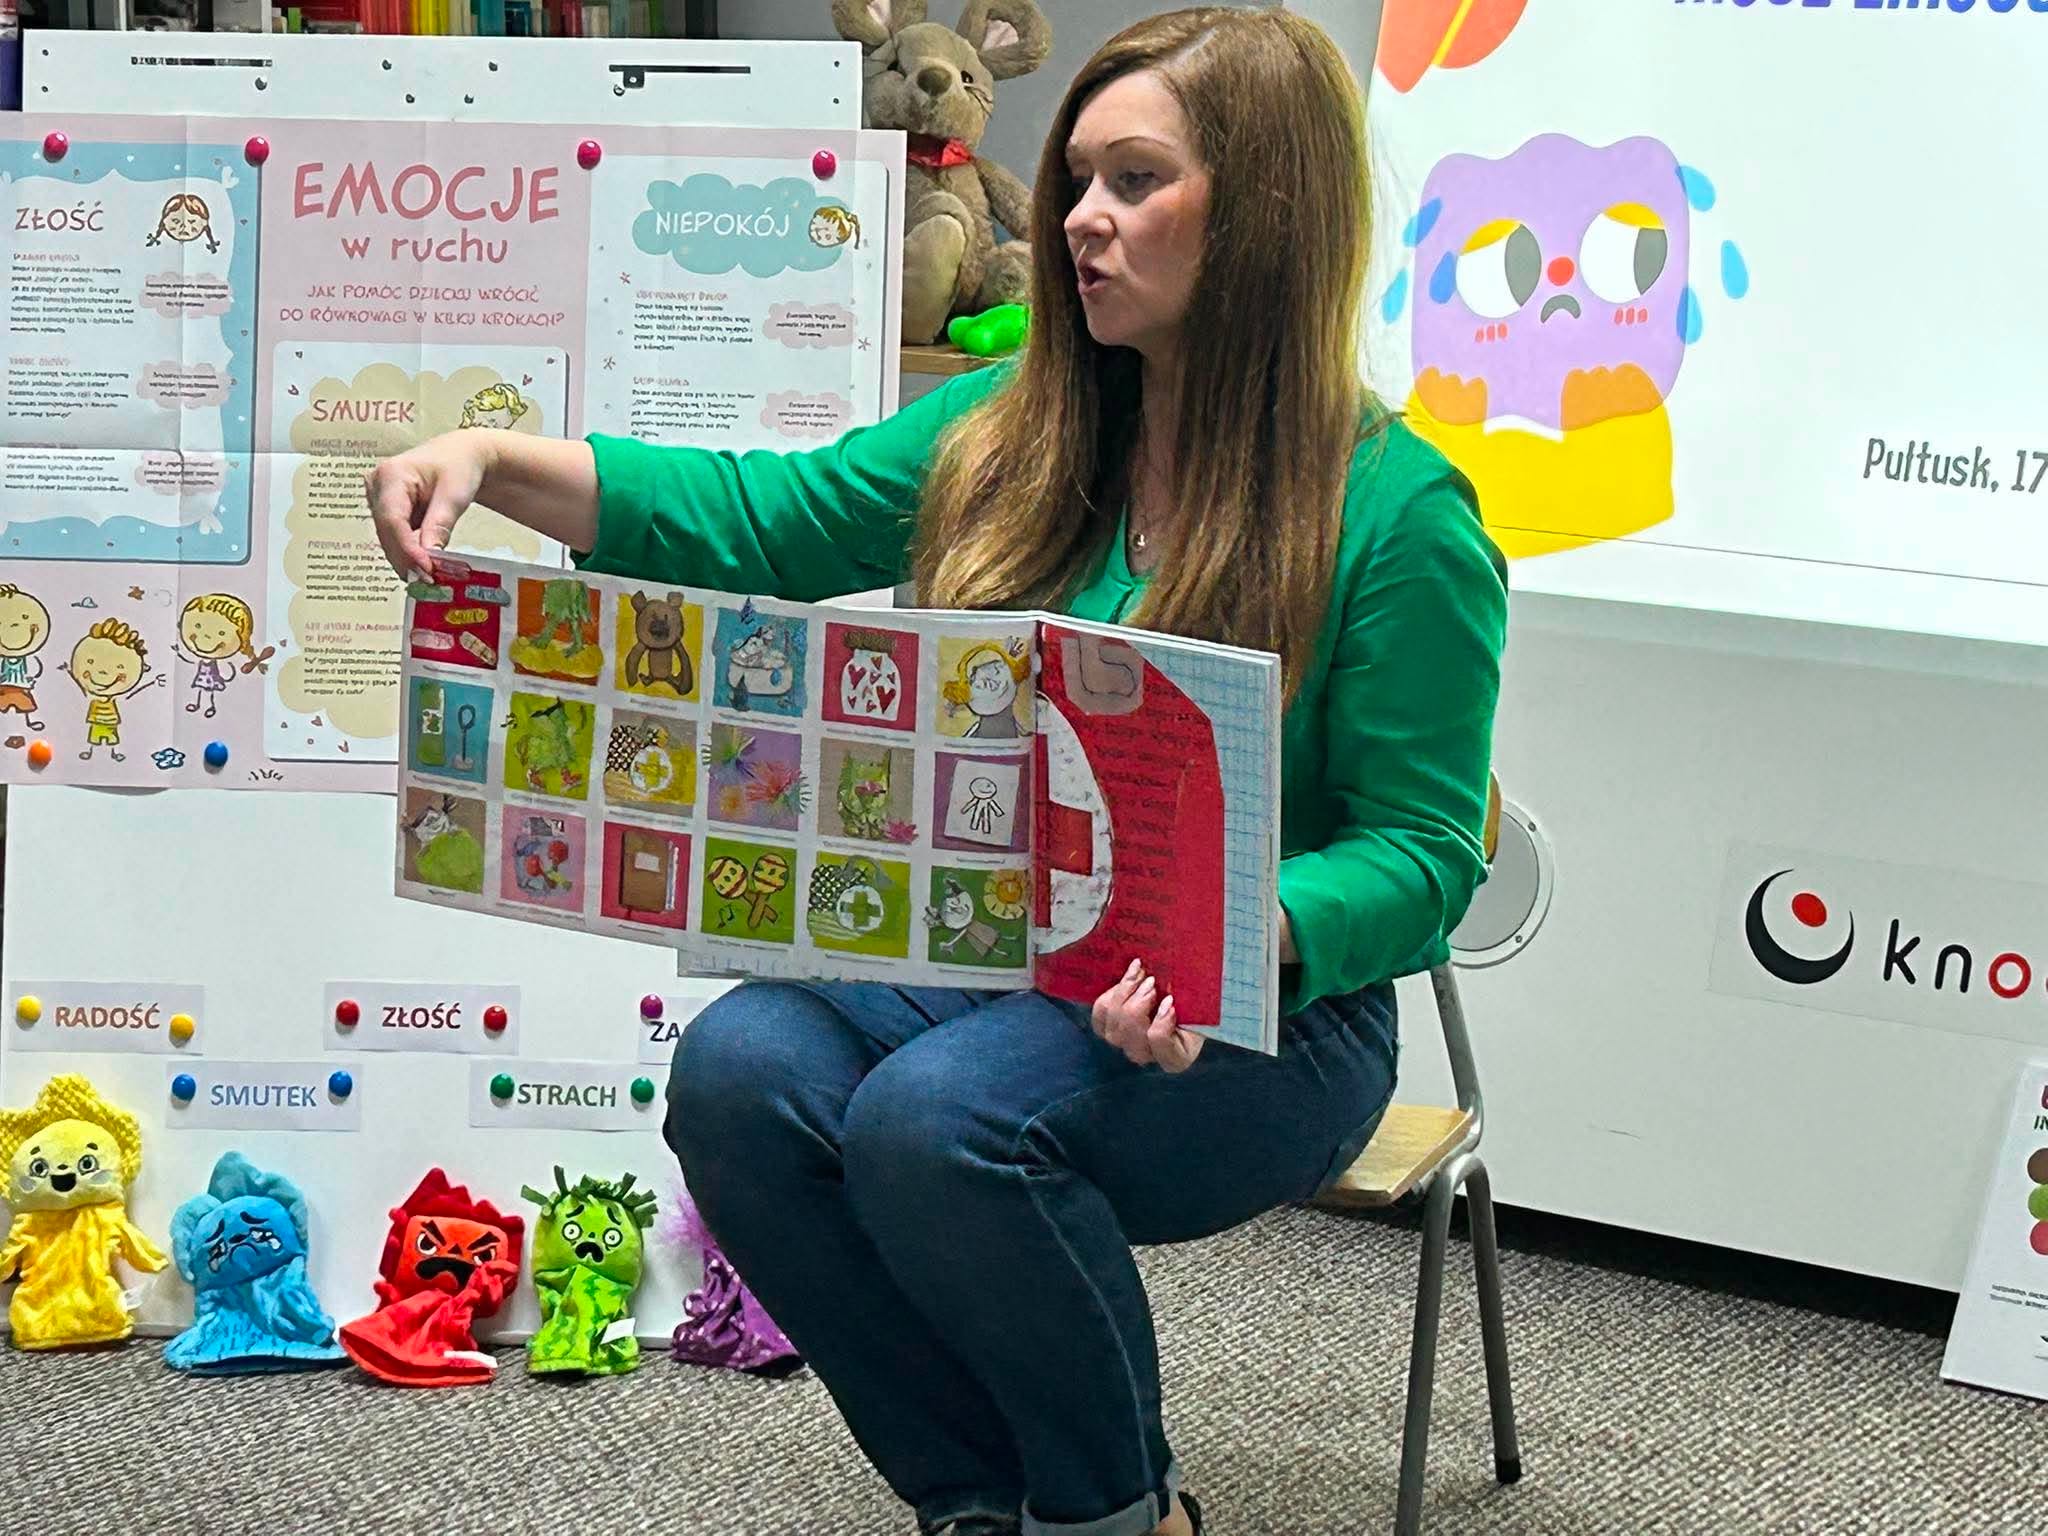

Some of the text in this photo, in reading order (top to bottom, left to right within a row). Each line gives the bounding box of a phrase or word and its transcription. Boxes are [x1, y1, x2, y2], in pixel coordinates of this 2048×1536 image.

[293, 161, 559, 224] EMOCJE
[15, 201, 104, 232] ZŁOŚĆ
[655, 207, 790, 238] NIEPOKÓJ
[341, 228, 508, 264] w ruchu
[307, 285, 336, 299] JAK
[343, 284, 402, 300] POMÓC
[279, 308, 304, 322] DO
[312, 399, 415, 424] SMUTEK
[1883, 918, 2048, 999] kno
[55, 1002, 161, 1029] RADOŚĆ
[382, 1001, 462, 1029] ZŁOŚĆ
[210, 1084, 318, 1108] SMUTEK
[517, 1083, 618, 1108] STRACH
